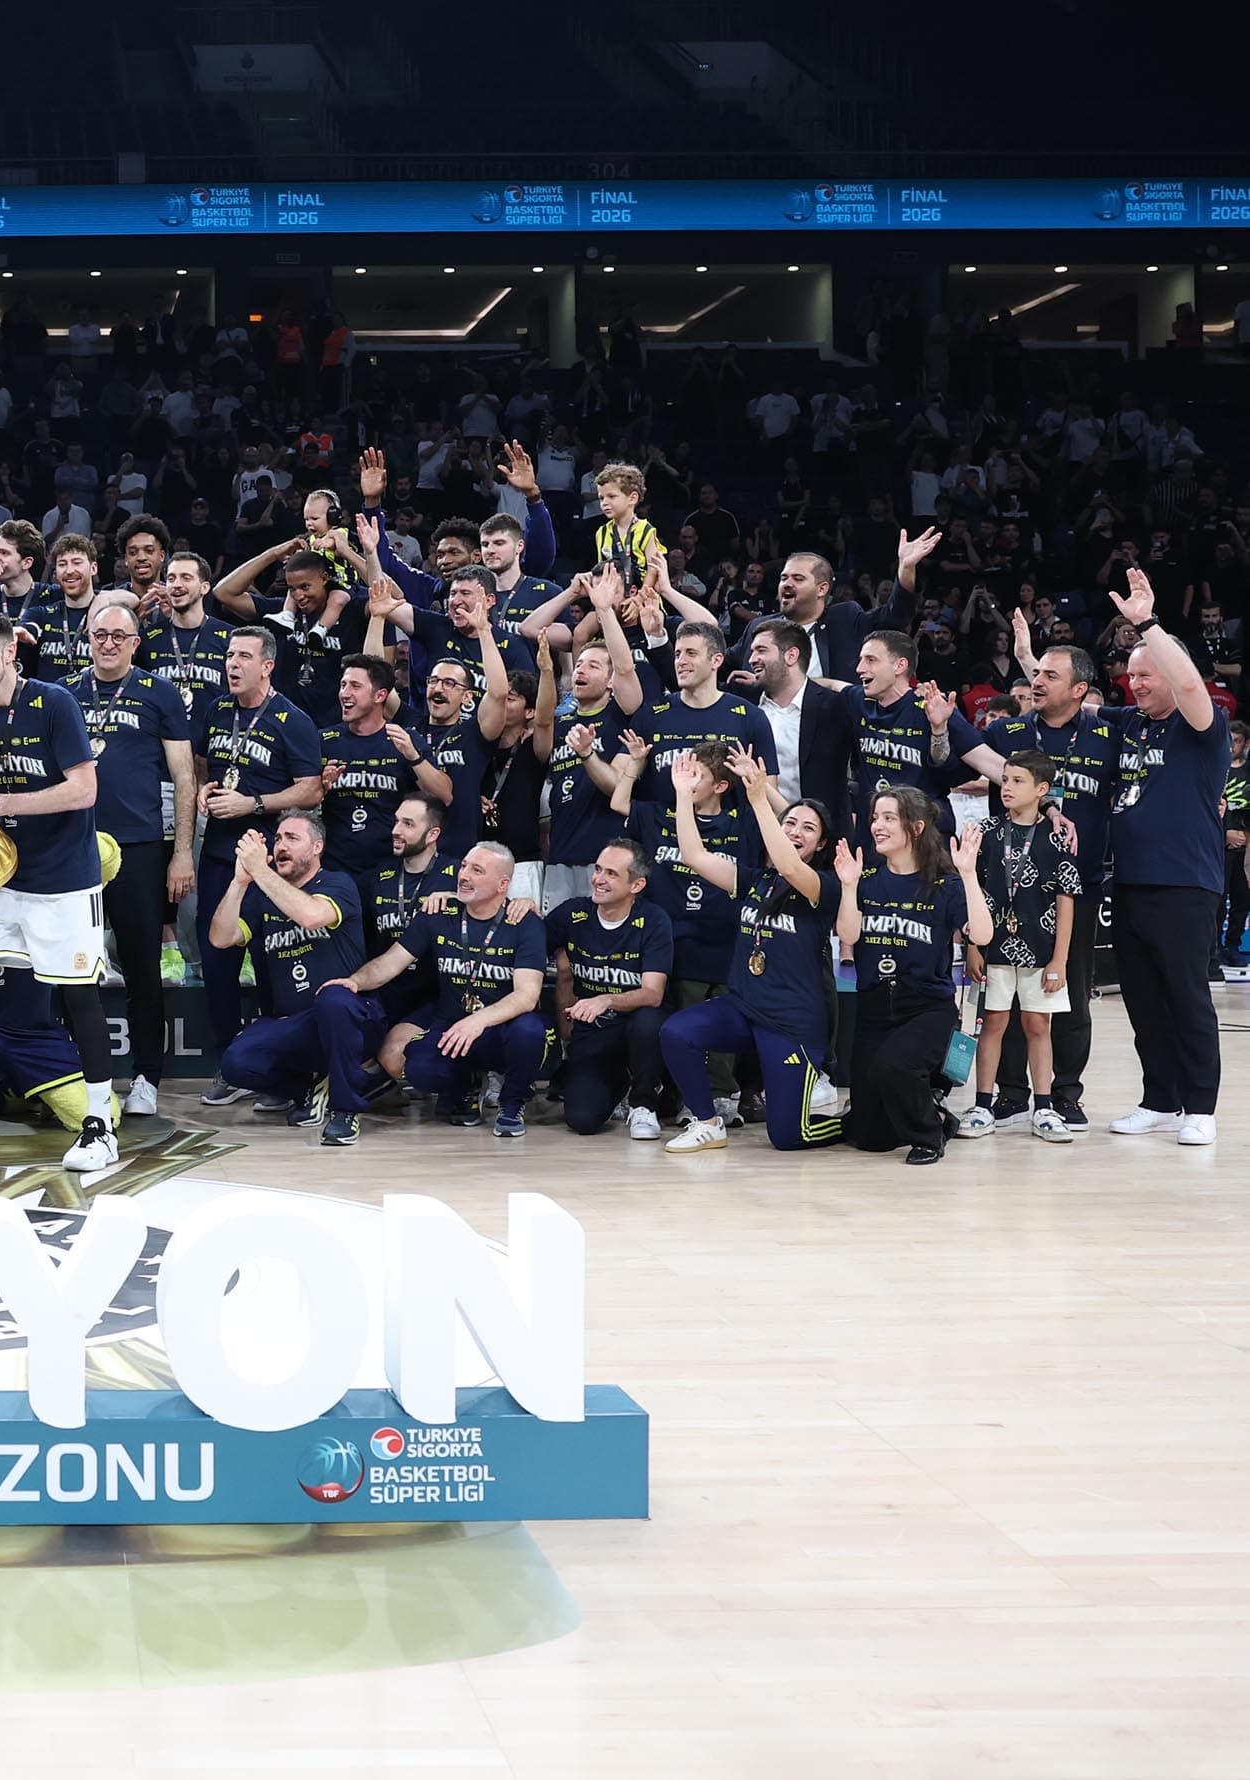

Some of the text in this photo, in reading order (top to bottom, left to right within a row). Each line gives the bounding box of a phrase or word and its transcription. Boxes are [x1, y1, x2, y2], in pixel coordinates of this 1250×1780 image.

[277, 191, 325, 206] FİNAL
[590, 188, 638, 204] FİNAL
[901, 188, 947, 203] FİNAL
[191, 208, 254, 218] BASKETBOL
[505, 206, 567, 216] BASKETBOL
[816, 204, 878, 214] BASKETBOL
[901, 207, 942, 222] 2026
[1126, 203, 1188, 212] BASKETBOL
[1212, 206, 1250, 220] 2026
[278, 210, 319, 225] 2026
[591, 208, 632, 223] 2026
[370, 1465, 496, 1484] BASKETBOL
[370, 1482, 484, 1504] SÜPER LİGİ
